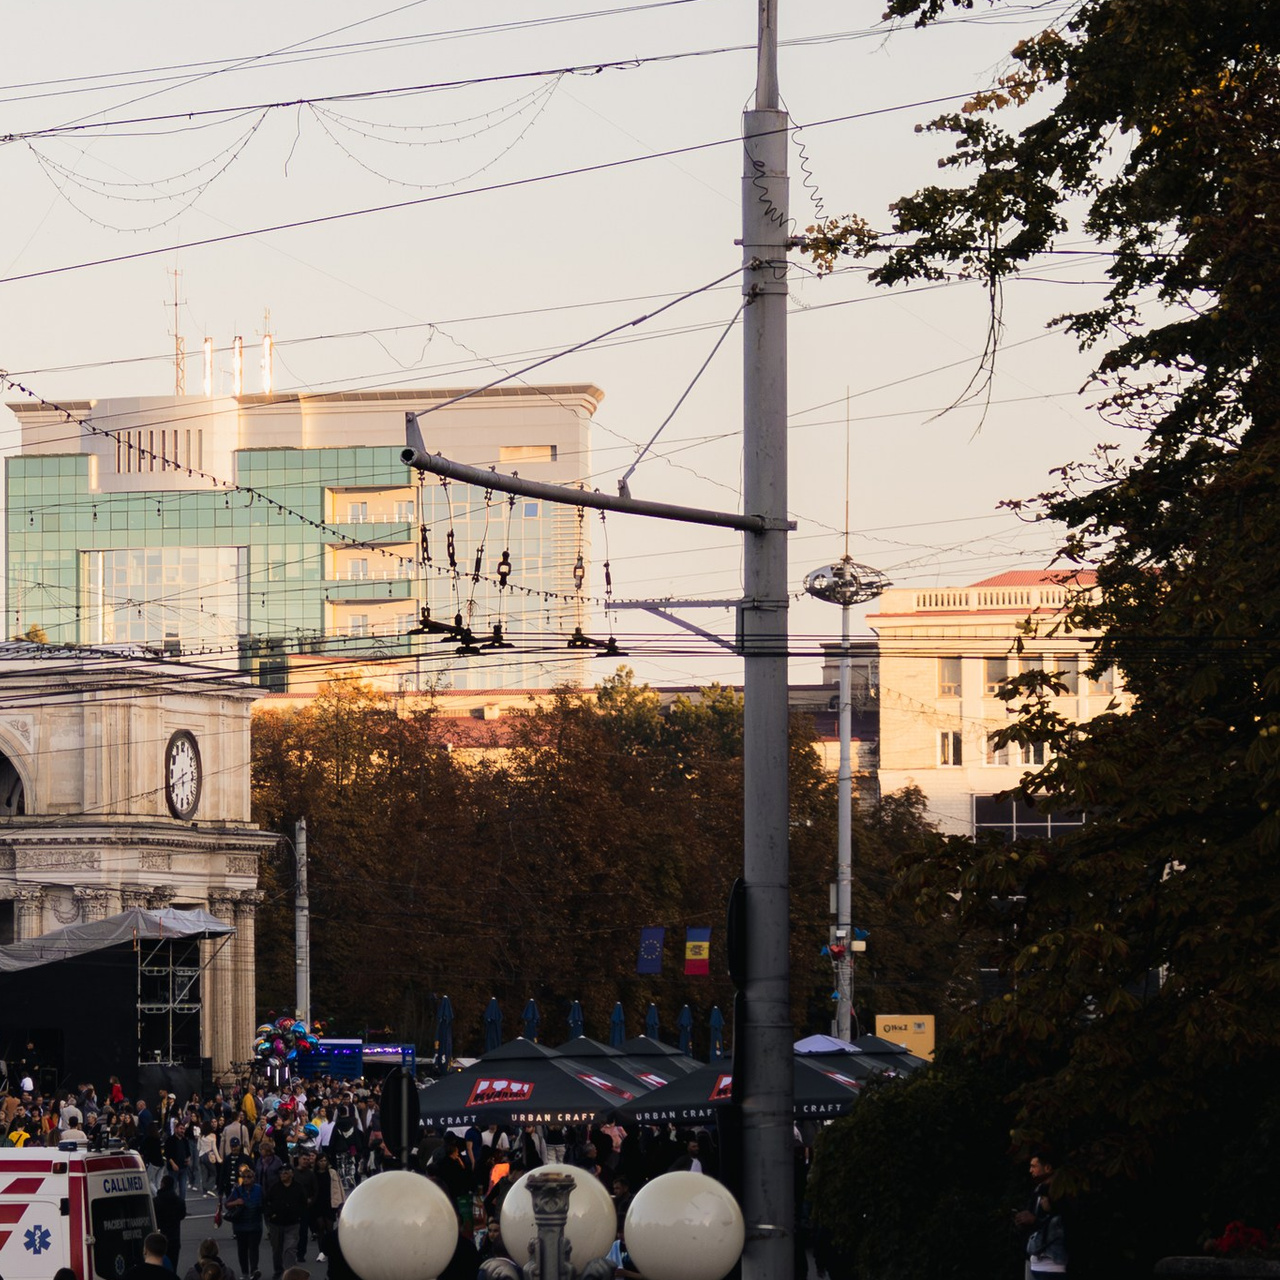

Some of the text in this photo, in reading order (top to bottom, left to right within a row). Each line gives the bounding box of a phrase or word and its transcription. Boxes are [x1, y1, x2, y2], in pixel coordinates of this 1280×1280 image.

[803, 1104, 842, 1113] CRAFT
[511, 1113, 596, 1122] URBAN CRAFT
[636, 1108, 717, 1120] URBAN CRAF
[440, 1115, 477, 1125] CRAFT
[103, 1176, 143, 1193] CALLMED
